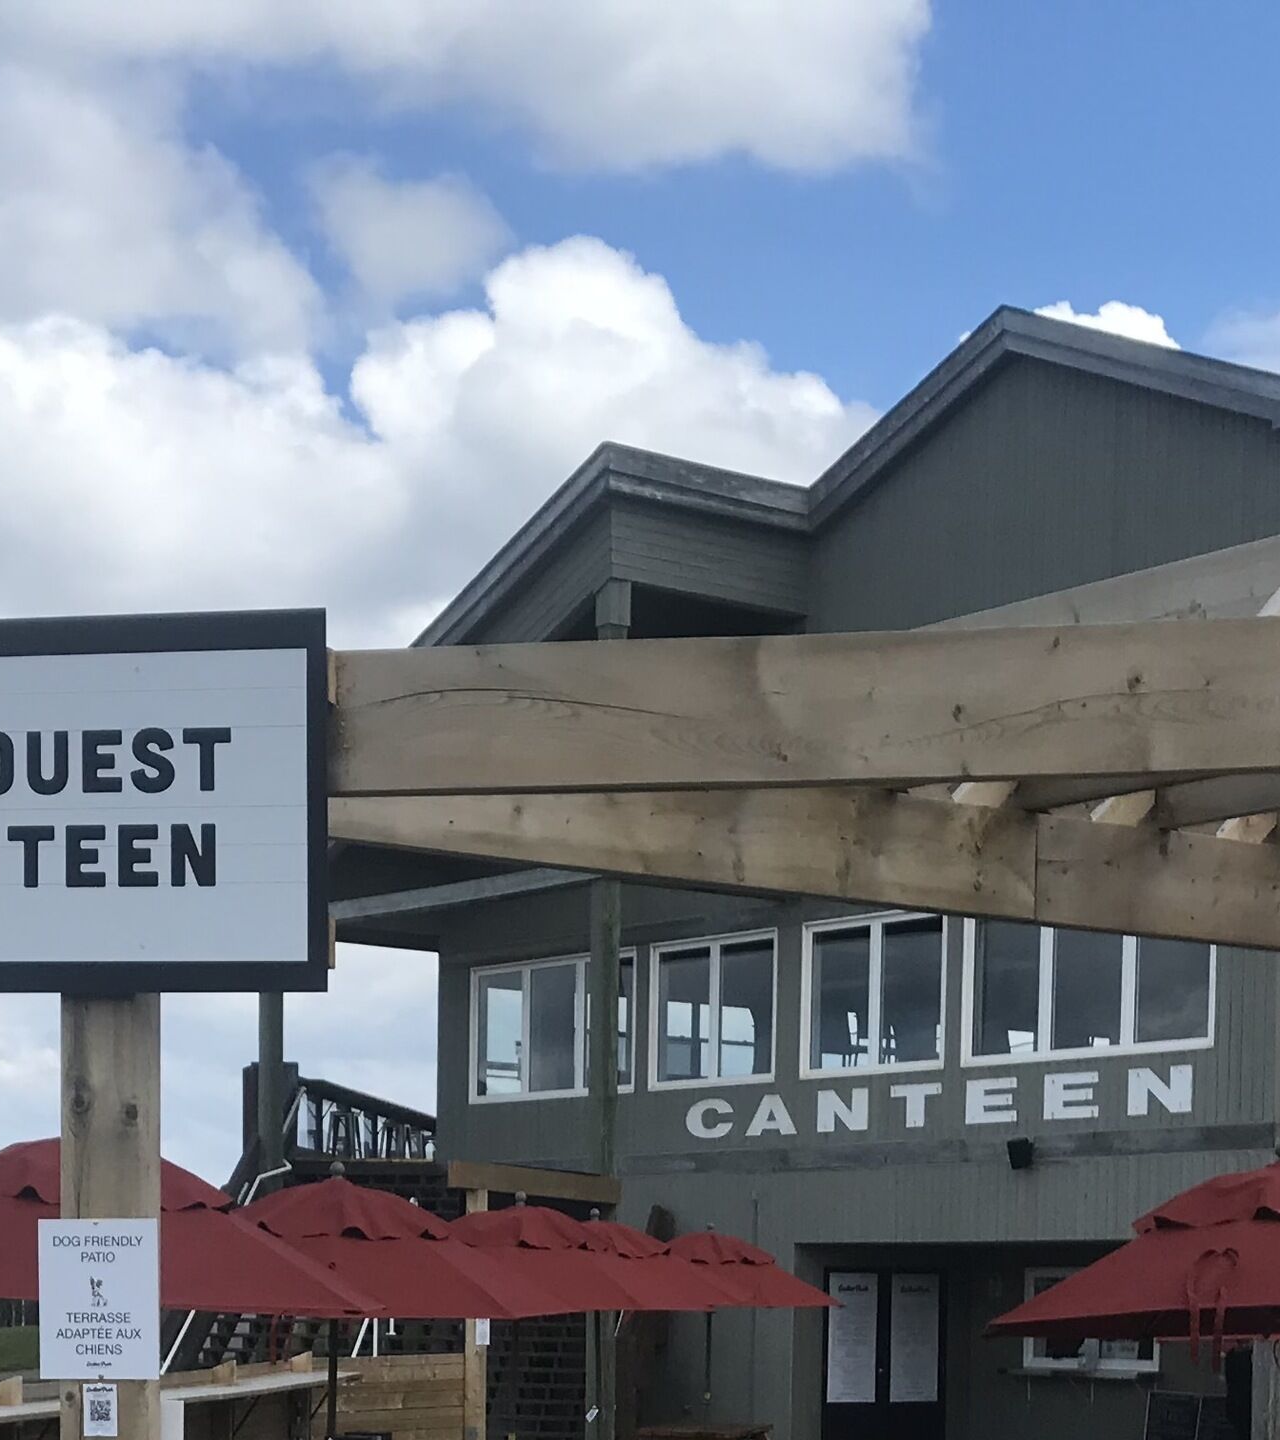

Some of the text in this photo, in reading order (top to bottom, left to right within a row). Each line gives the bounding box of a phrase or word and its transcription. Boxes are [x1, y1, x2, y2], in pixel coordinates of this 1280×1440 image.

[685, 1064, 1193, 1139] CANTEEN
[52, 1235, 143, 1247] DOG FRIENDLY
[80, 1251, 116, 1263] PATIO
[66, 1312, 131, 1323] TERRASSE
[56, 1326, 142, 1339] ADAPTÉE AUX
[75, 1343, 123, 1355] CHIENS
